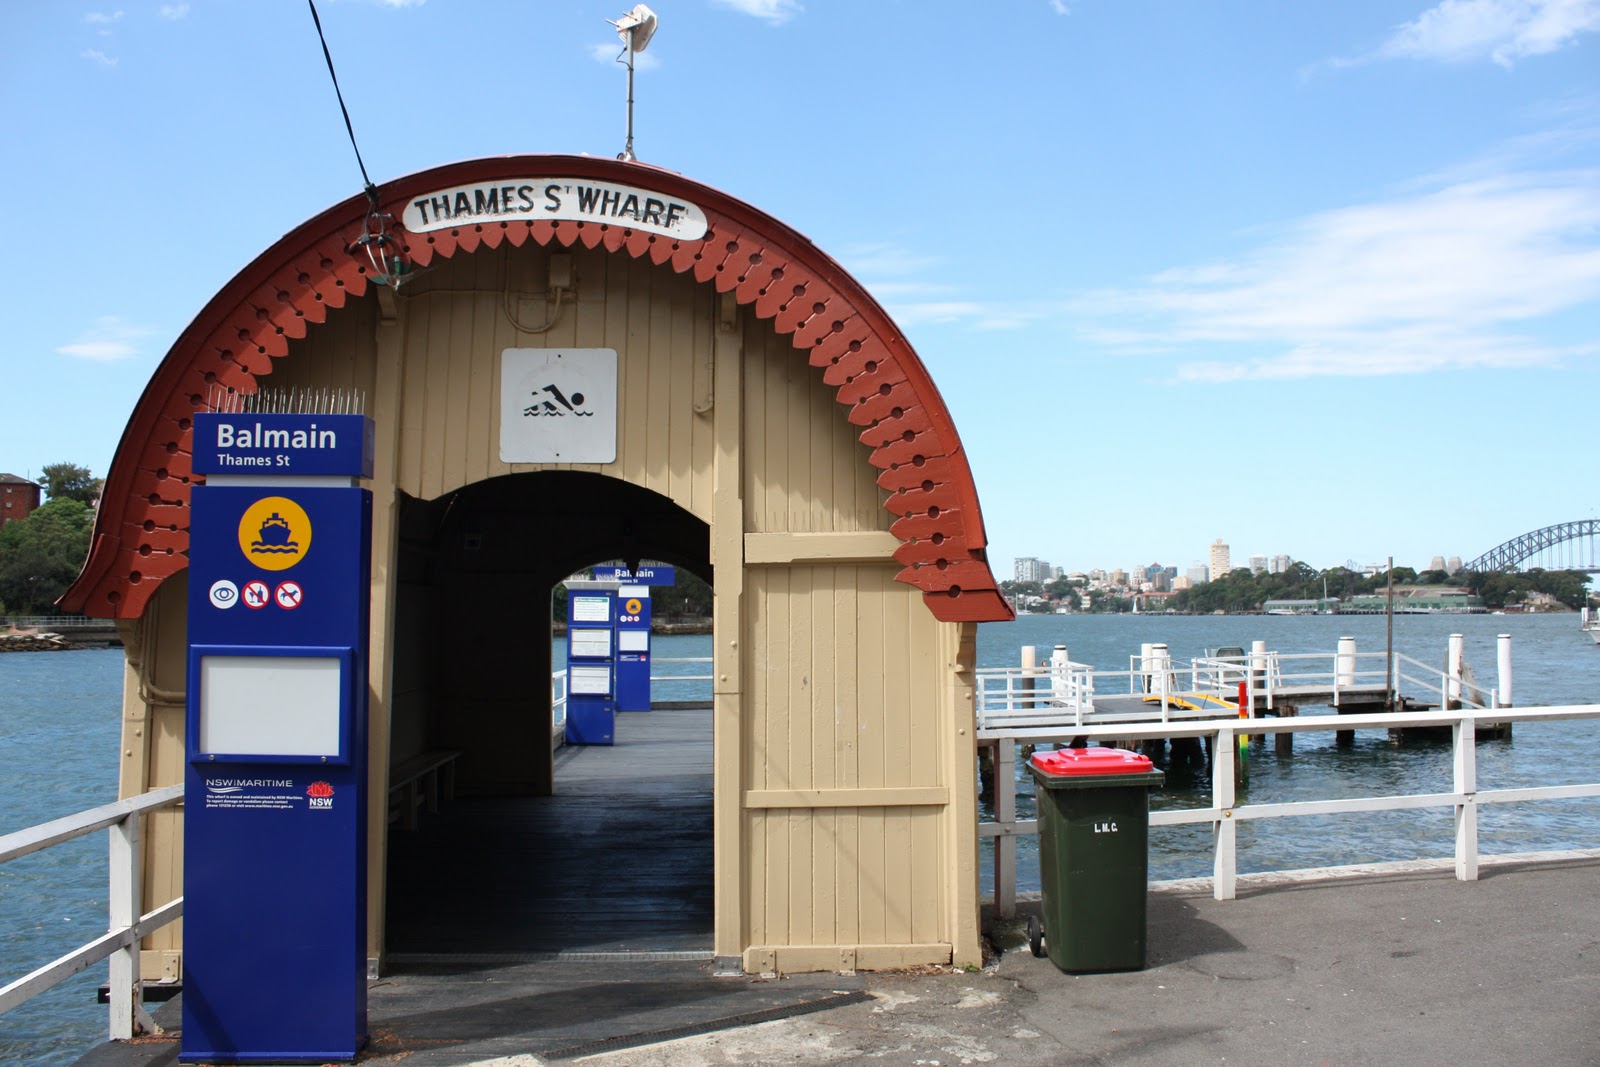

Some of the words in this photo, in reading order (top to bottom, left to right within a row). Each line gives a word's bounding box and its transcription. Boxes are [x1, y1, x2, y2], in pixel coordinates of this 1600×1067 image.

[414, 185, 534, 226] THAMES
[577, 186, 686, 229] WHARF
[217, 422, 336, 449] Balmain
[217, 454, 271, 466] Thames
[276, 454, 290, 466] St
[309, 797, 333, 806] NSW
